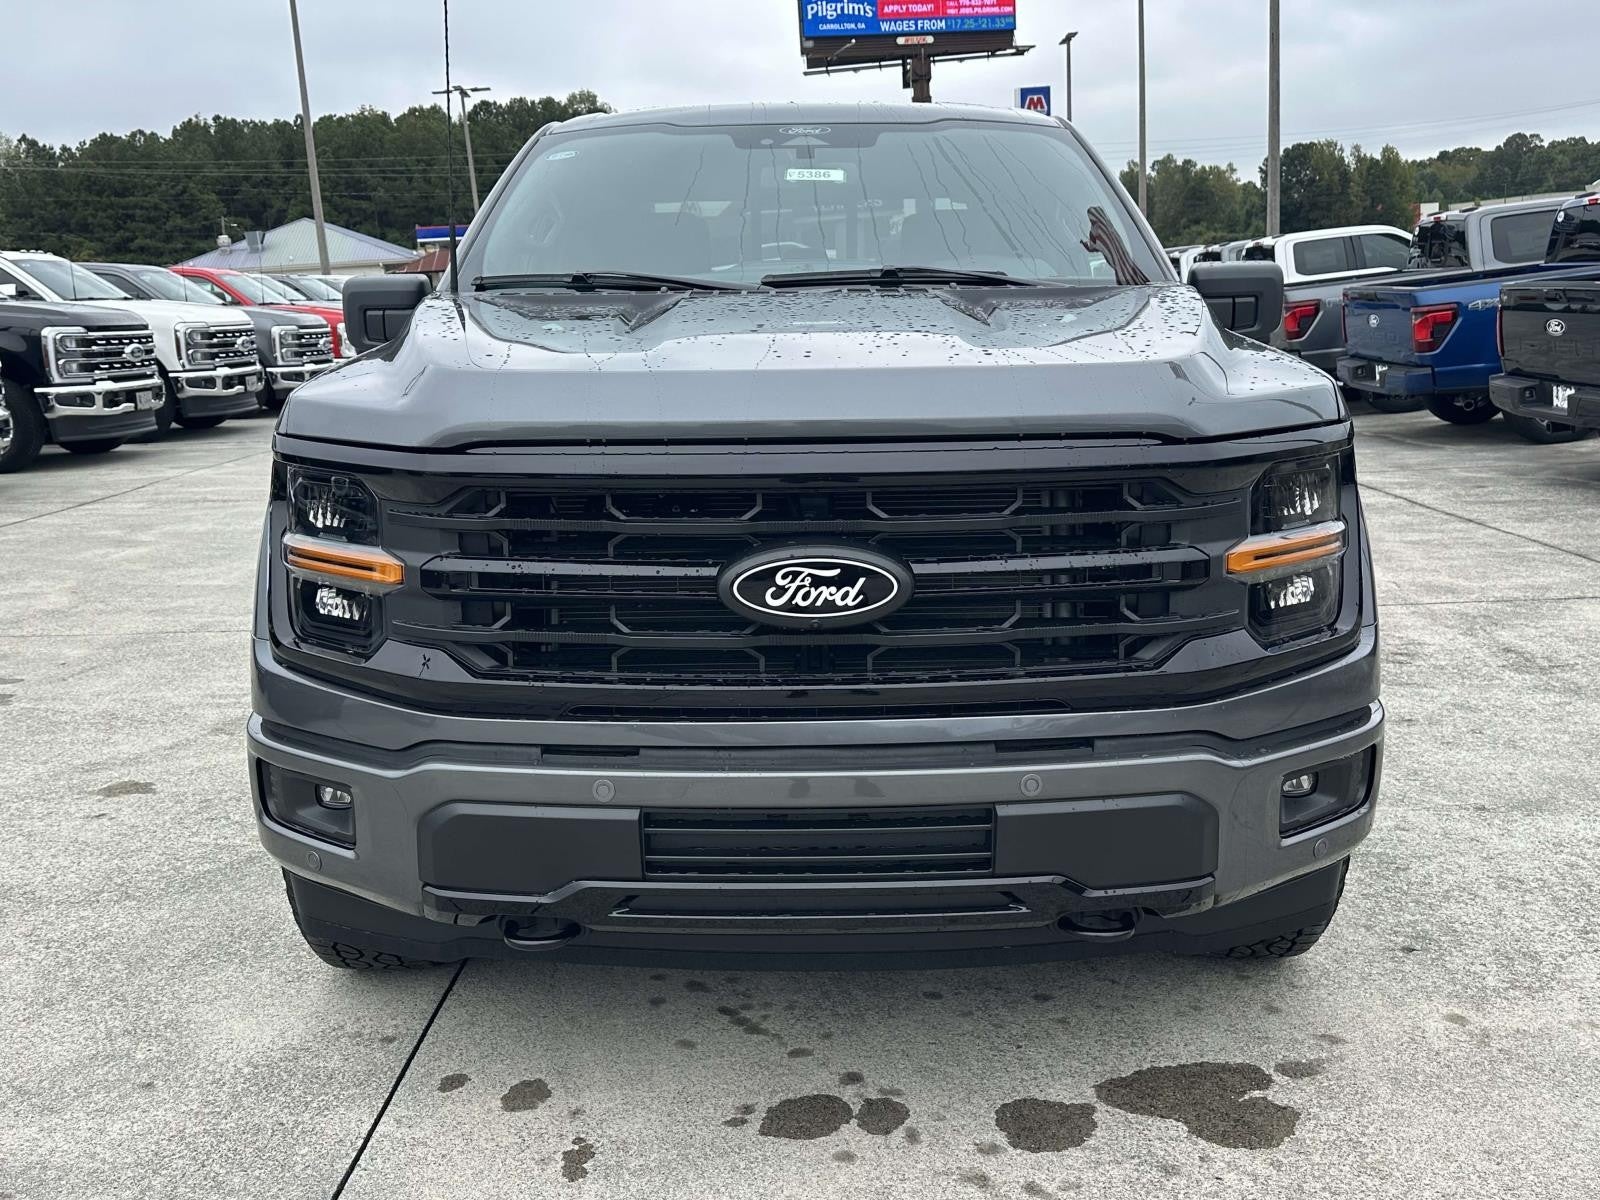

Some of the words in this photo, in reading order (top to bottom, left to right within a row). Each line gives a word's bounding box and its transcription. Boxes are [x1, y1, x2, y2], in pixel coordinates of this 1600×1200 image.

[883, 4, 907, 13] APPLY
[908, 3, 934, 12] TODAY!
[818, 22, 857, 31] CARROLLTON,
[880, 20, 916, 31] WAGES
[917, 19, 946, 30] FROM
[765, 566, 867, 607] Ford
